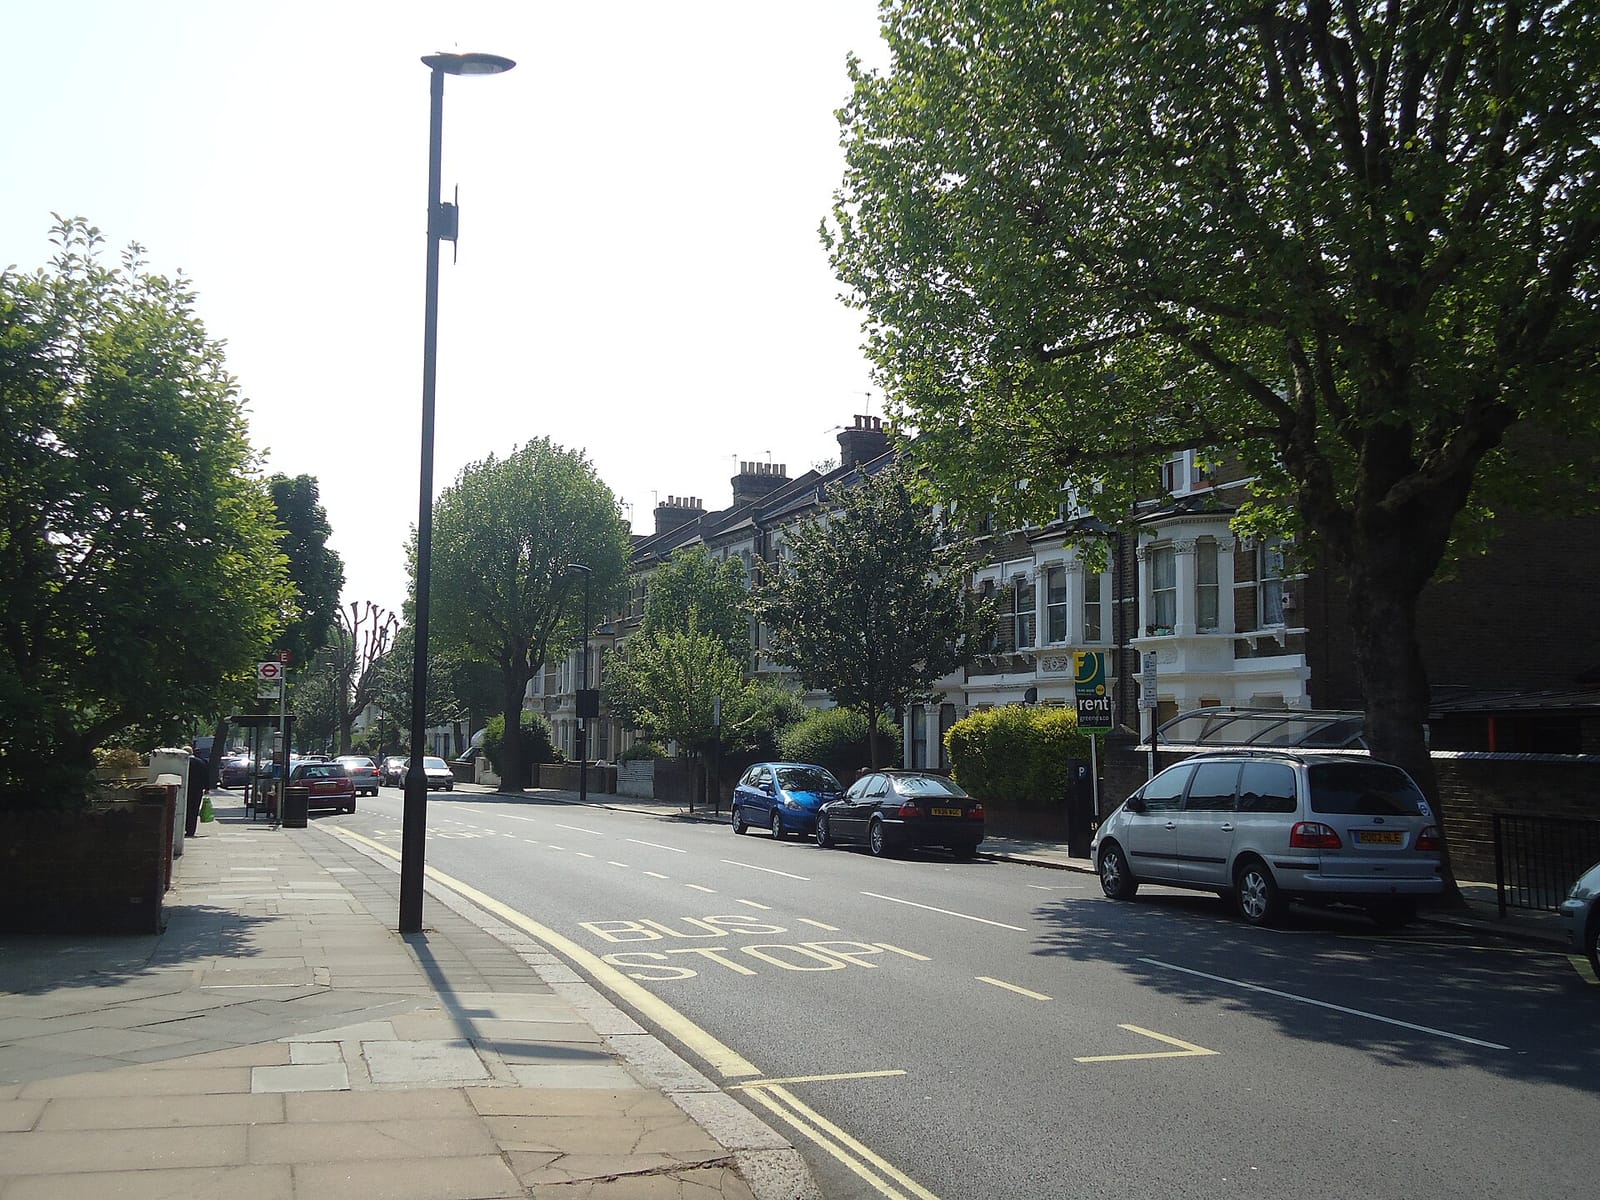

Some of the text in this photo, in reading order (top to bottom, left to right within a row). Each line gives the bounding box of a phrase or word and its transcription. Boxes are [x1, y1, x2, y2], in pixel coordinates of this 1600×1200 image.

[281, 653, 287, 662] E
[1079, 697, 1109, 711] rent
[1079, 766, 1085, 777] P
[578, 915, 788, 942] BUS
[600, 941, 884, 981] STOP
